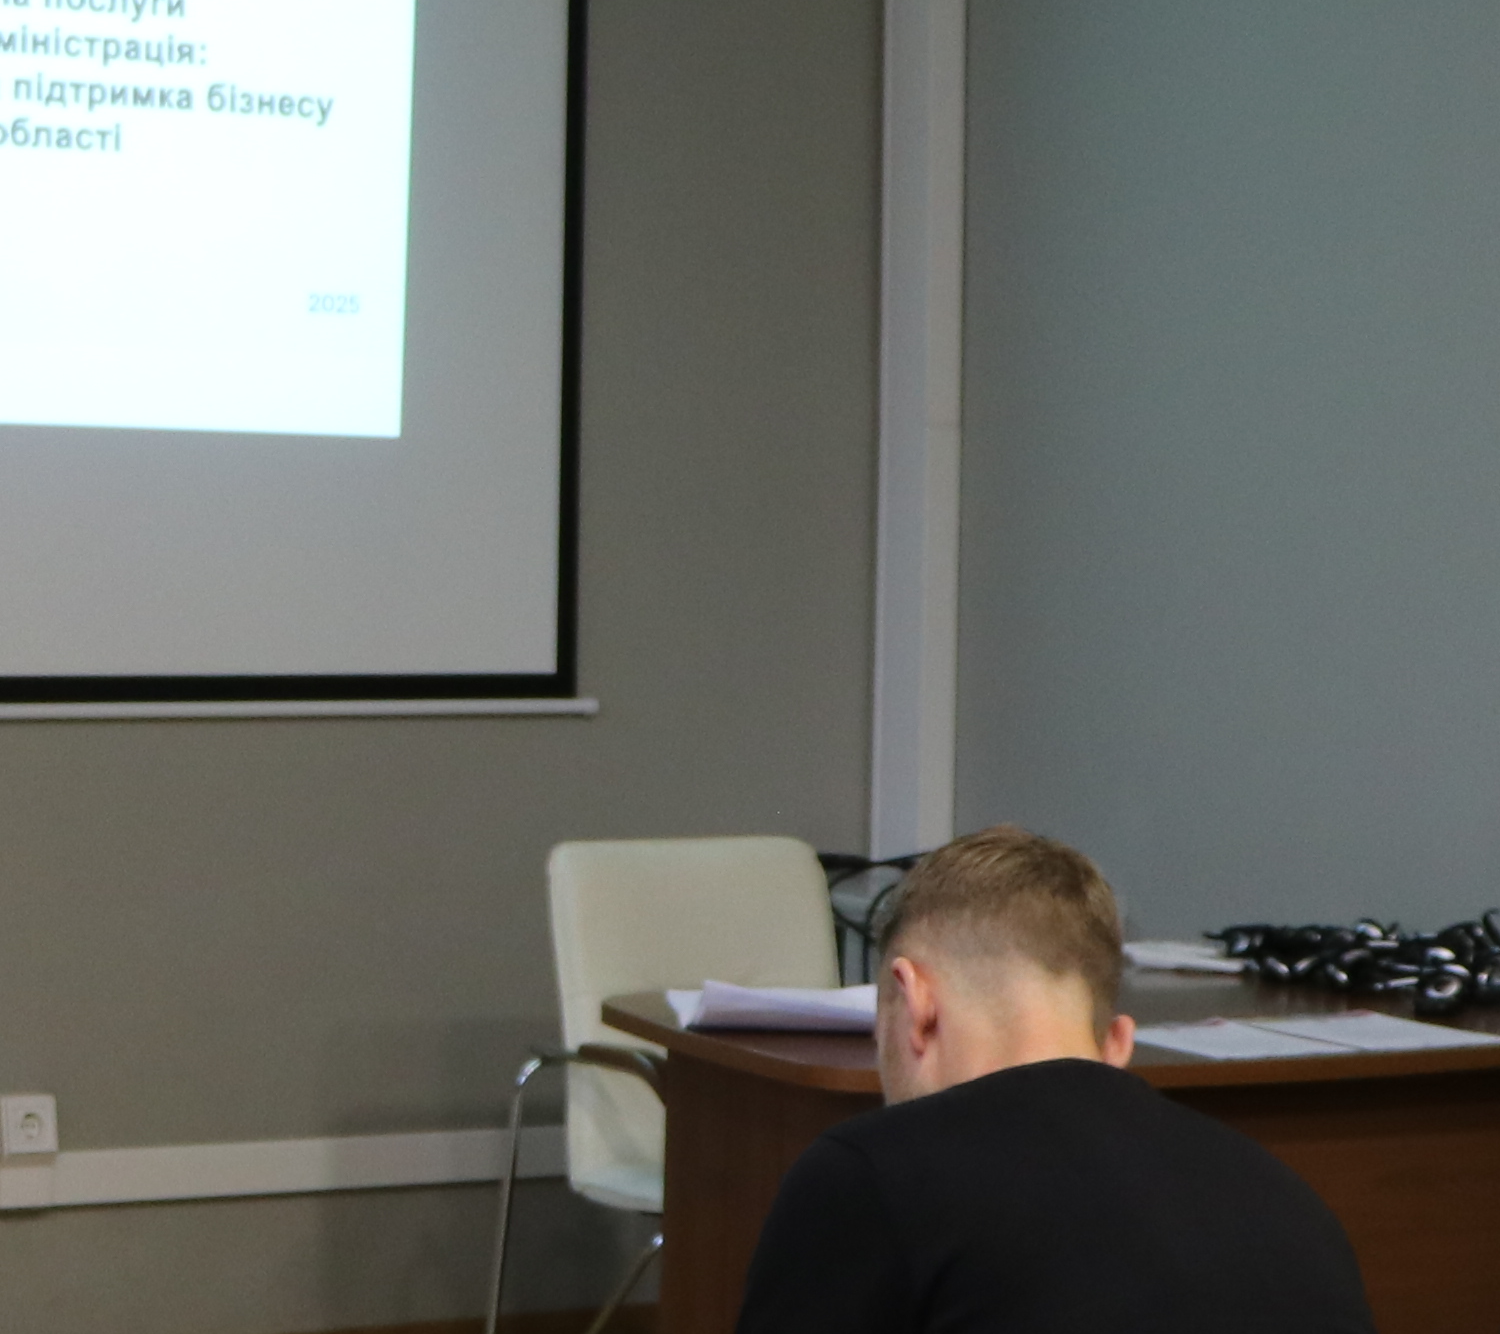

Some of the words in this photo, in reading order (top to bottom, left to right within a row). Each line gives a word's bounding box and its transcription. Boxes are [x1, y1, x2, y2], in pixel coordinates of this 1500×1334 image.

[13, 73, 194, 113] підтримка
[205, 82, 335, 129] бізнесу
[308, 293, 360, 314] 2025
